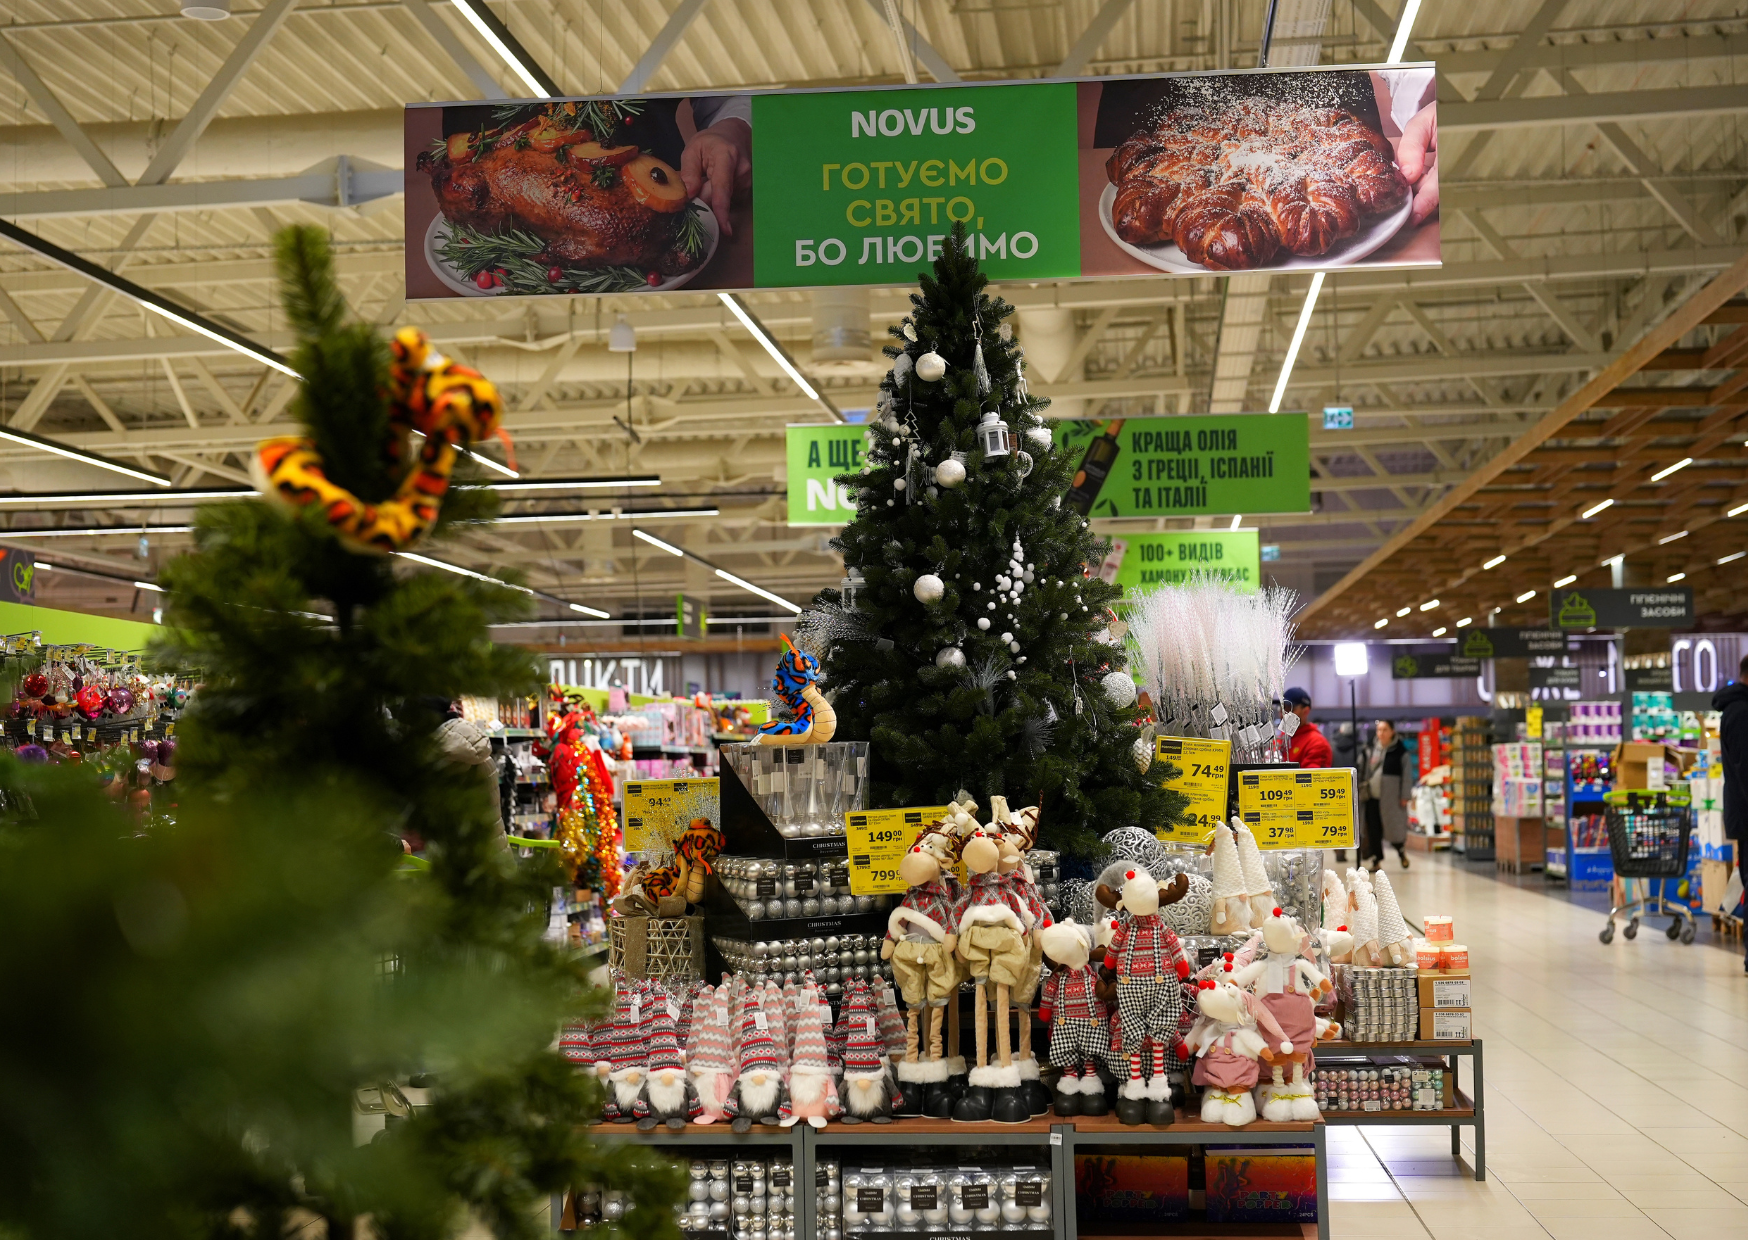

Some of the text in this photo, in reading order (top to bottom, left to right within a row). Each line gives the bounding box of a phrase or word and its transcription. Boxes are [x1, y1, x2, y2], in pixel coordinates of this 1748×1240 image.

[851, 106, 976, 138] NOVUS
[822, 157, 1008, 191] ГОТУЄМО
[846, 196, 985, 230] СВЯТО,
[795, 238, 847, 267] БО
[1132, 429, 1237, 455] КРАЩА ОЛІЯ
[808, 439, 861, 471] А ЩЕ
[1132, 459, 1143, 481] З
[1210, 451, 1274, 479] ІСПАНІЇ
[1132, 480, 1208, 509] ТА ІТАЛІЇ
[1139, 542, 1223, 562] 100+ ВИДІВ
[1641, 606, 1686, 618] ЗАСОБИ
[1191, 763, 1224, 778] 74 49
[1260, 789, 1283, 801] 109
[1320, 788, 1336, 799] 59
[648, 797, 663, 807] 94
[868, 830, 893, 843] 149
[1268, 826, 1294, 838] 37 98
[1321, 826, 1337, 837] 79
[812, 841, 846, 849] CHRISTMAS
[870, 869, 896, 881] 799
[807, 920, 842, 928] CHRISTMAS
[1105, 1189, 1154, 1199] PARTY
[1239, 1190, 1289, 1200] PARTY
[1237, 1199, 1293, 1210] POPPER
